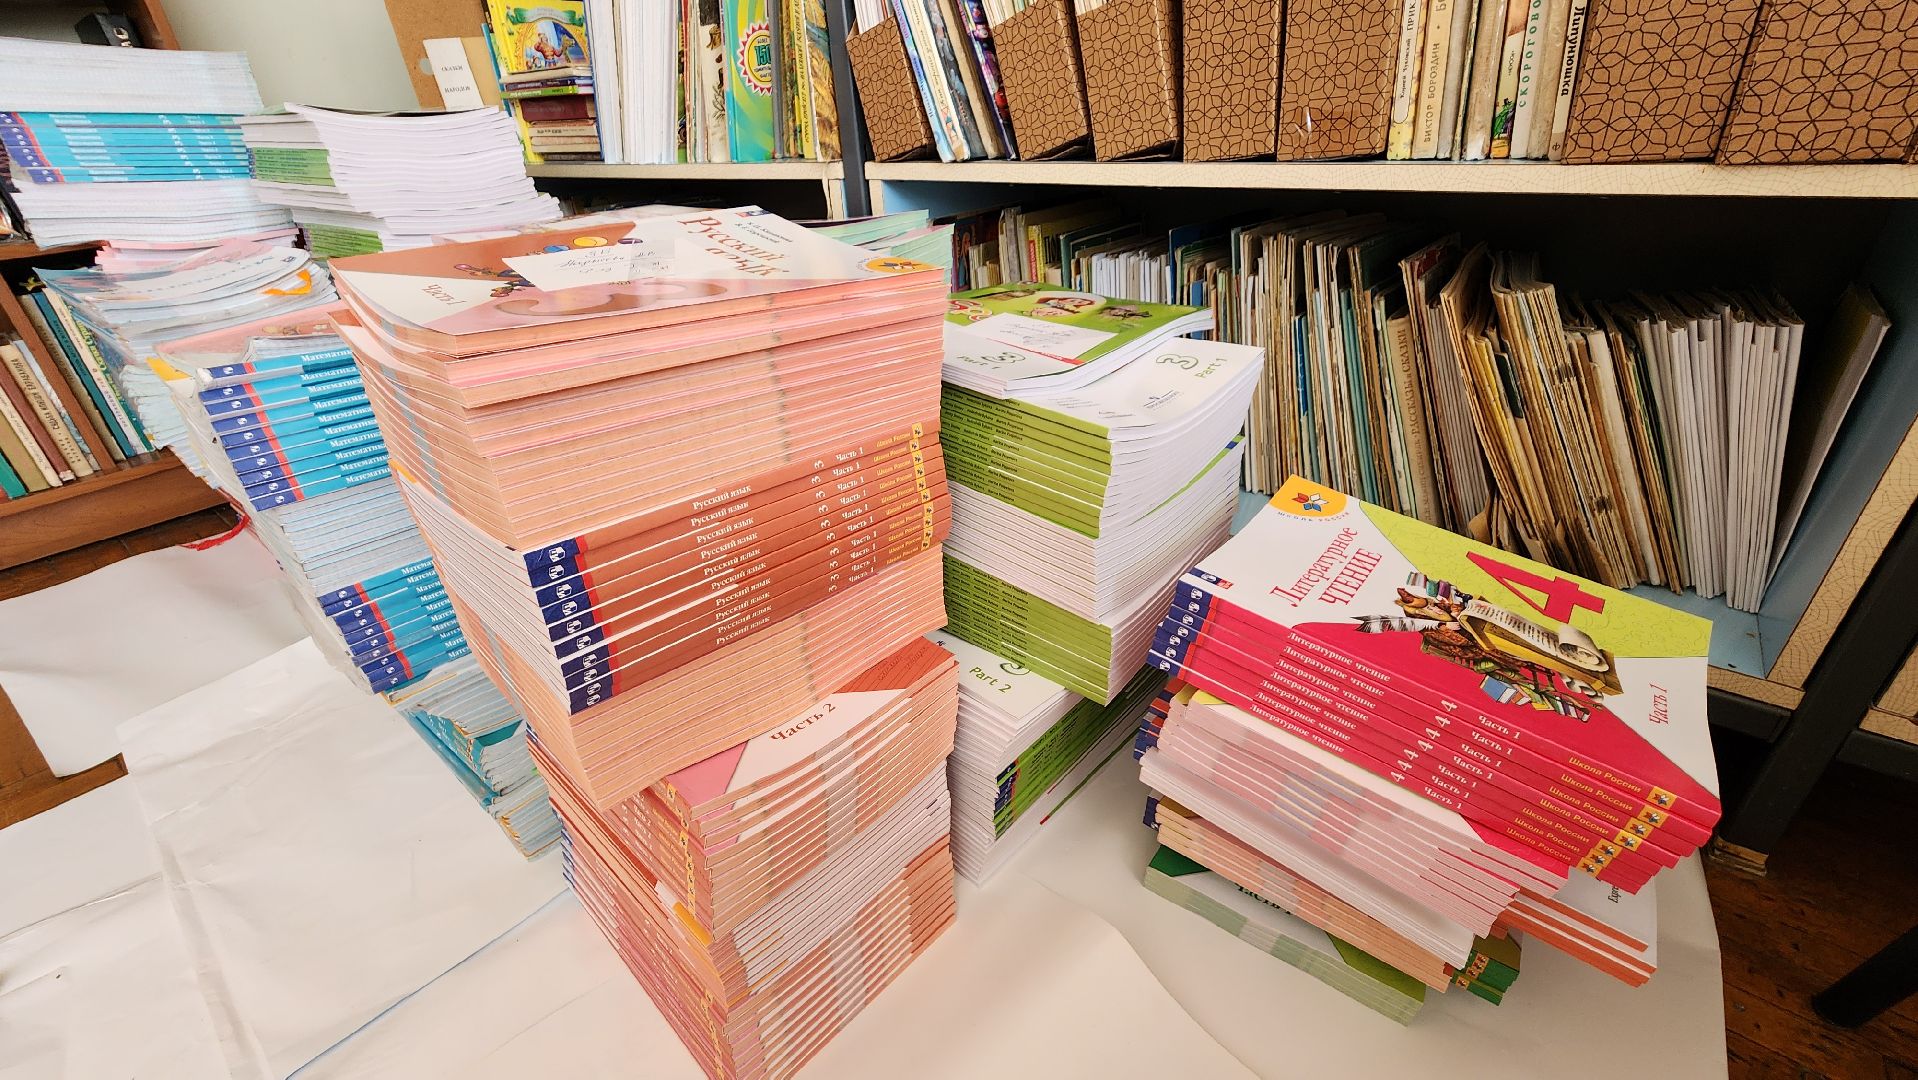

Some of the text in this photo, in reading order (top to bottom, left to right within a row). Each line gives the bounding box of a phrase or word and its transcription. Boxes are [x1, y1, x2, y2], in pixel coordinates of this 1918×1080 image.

[1407, 0, 1417, 30] ПРИК
[1561, 6, 1585, 96] Липунюшка
[1424, 43, 1440, 143] ВИКТОР БОРОЗДИН
[677, 216, 785, 261] Русский
[1156, 353, 1199, 369] 3
[1194, 363, 1221, 378] Part
[1397, 328, 1412, 374] СКАЗКИ
[1403, 381, 1421, 434] РАССКАЗЫ
[691, 508, 727, 526] Русский
[728, 502, 749, 513] язык
[833, 466, 853, 476] Часть
[692, 492, 729, 510] Русский
[730, 486, 751, 497] язык
[836, 451, 857, 461] Часть
[697, 525, 732, 543] Русский
[734, 518, 754, 529] язык
[837, 481, 857, 490] Часть
[700, 541, 736, 559] Русский
[737, 533, 758, 545] язык
[840, 494, 860, 504] Часть
[704, 557, 738, 575] Русский
[740, 549, 760, 560] язык
[842, 508, 862, 519] Часть
[711, 571, 746, 590] Русский
[747, 562, 767, 575] язык
[847, 521, 867, 531] Часть
[716, 587, 750, 606] Русский
[751, 578, 771, 591] язык
[851, 535, 870, 546] Часть
[1269, 527, 1358, 607] Литературное
[1318, 548, 1382, 605] ЧТЕНИЕ
[715, 601, 749, 620] Русский
[1466, 551, 1606, 624] 4
[716, 626, 749, 645] Русский
[718, 615, 751, 633] Русский
[970, 666, 998, 686] Part
[998, 683, 1012, 693] 2
[1649, 693, 1669, 725] Часть
[769, 703, 836, 740] Часть 2
[1276, 659, 1339, 692] Литературное
[1342, 690, 1376, 709] чтение
[1425, 728, 1440, 740] 4
[1549, 786, 1580, 805] Школа
[1583, 802, 1619, 823] России
[1284, 646, 1348, 679] Литературное
[1350, 678, 1385, 696] чтение
[1435, 716, 1450, 727] 4
[1561, 773, 1593, 793] Школа
[1596, 790, 1632, 811] России
[1288, 632, 1352, 665] Литературное
[1355, 663, 1391, 681] чтение
[1441, 700, 1457, 711] 4
[1569, 756, 1601, 775] Школа
[1604, 772, 1642, 793] России
[1250, 704, 1310, 737] Литературное
[1312, 735, 1345, 753] чтение
[1391, 771, 1405, 782] 4
[1507, 827, 1535, 845] Школа
[1538, 843, 1571, 862] России
[1255, 691, 1316, 724] Литературное
[1318, 722, 1351, 741] чтение
[1397, 760, 1412, 771] 4
[1515, 818, 1544, 837] Школа
[1547, 831, 1581, 853] России
[1260, 680, 1321, 712] Литературное
[1324, 710, 1357, 730] чтение
[1404, 749, 1418, 760] 4
[1522, 808, 1552, 827] Школа
[1555, 823, 1590, 843] России
[1271, 671, 1333, 704] Литературное
[1335, 702, 1369, 721] чтение
[1418, 740, 1433, 751] 4
[1540, 798, 1570, 818] Школа
[1574, 815, 1609, 835] России
